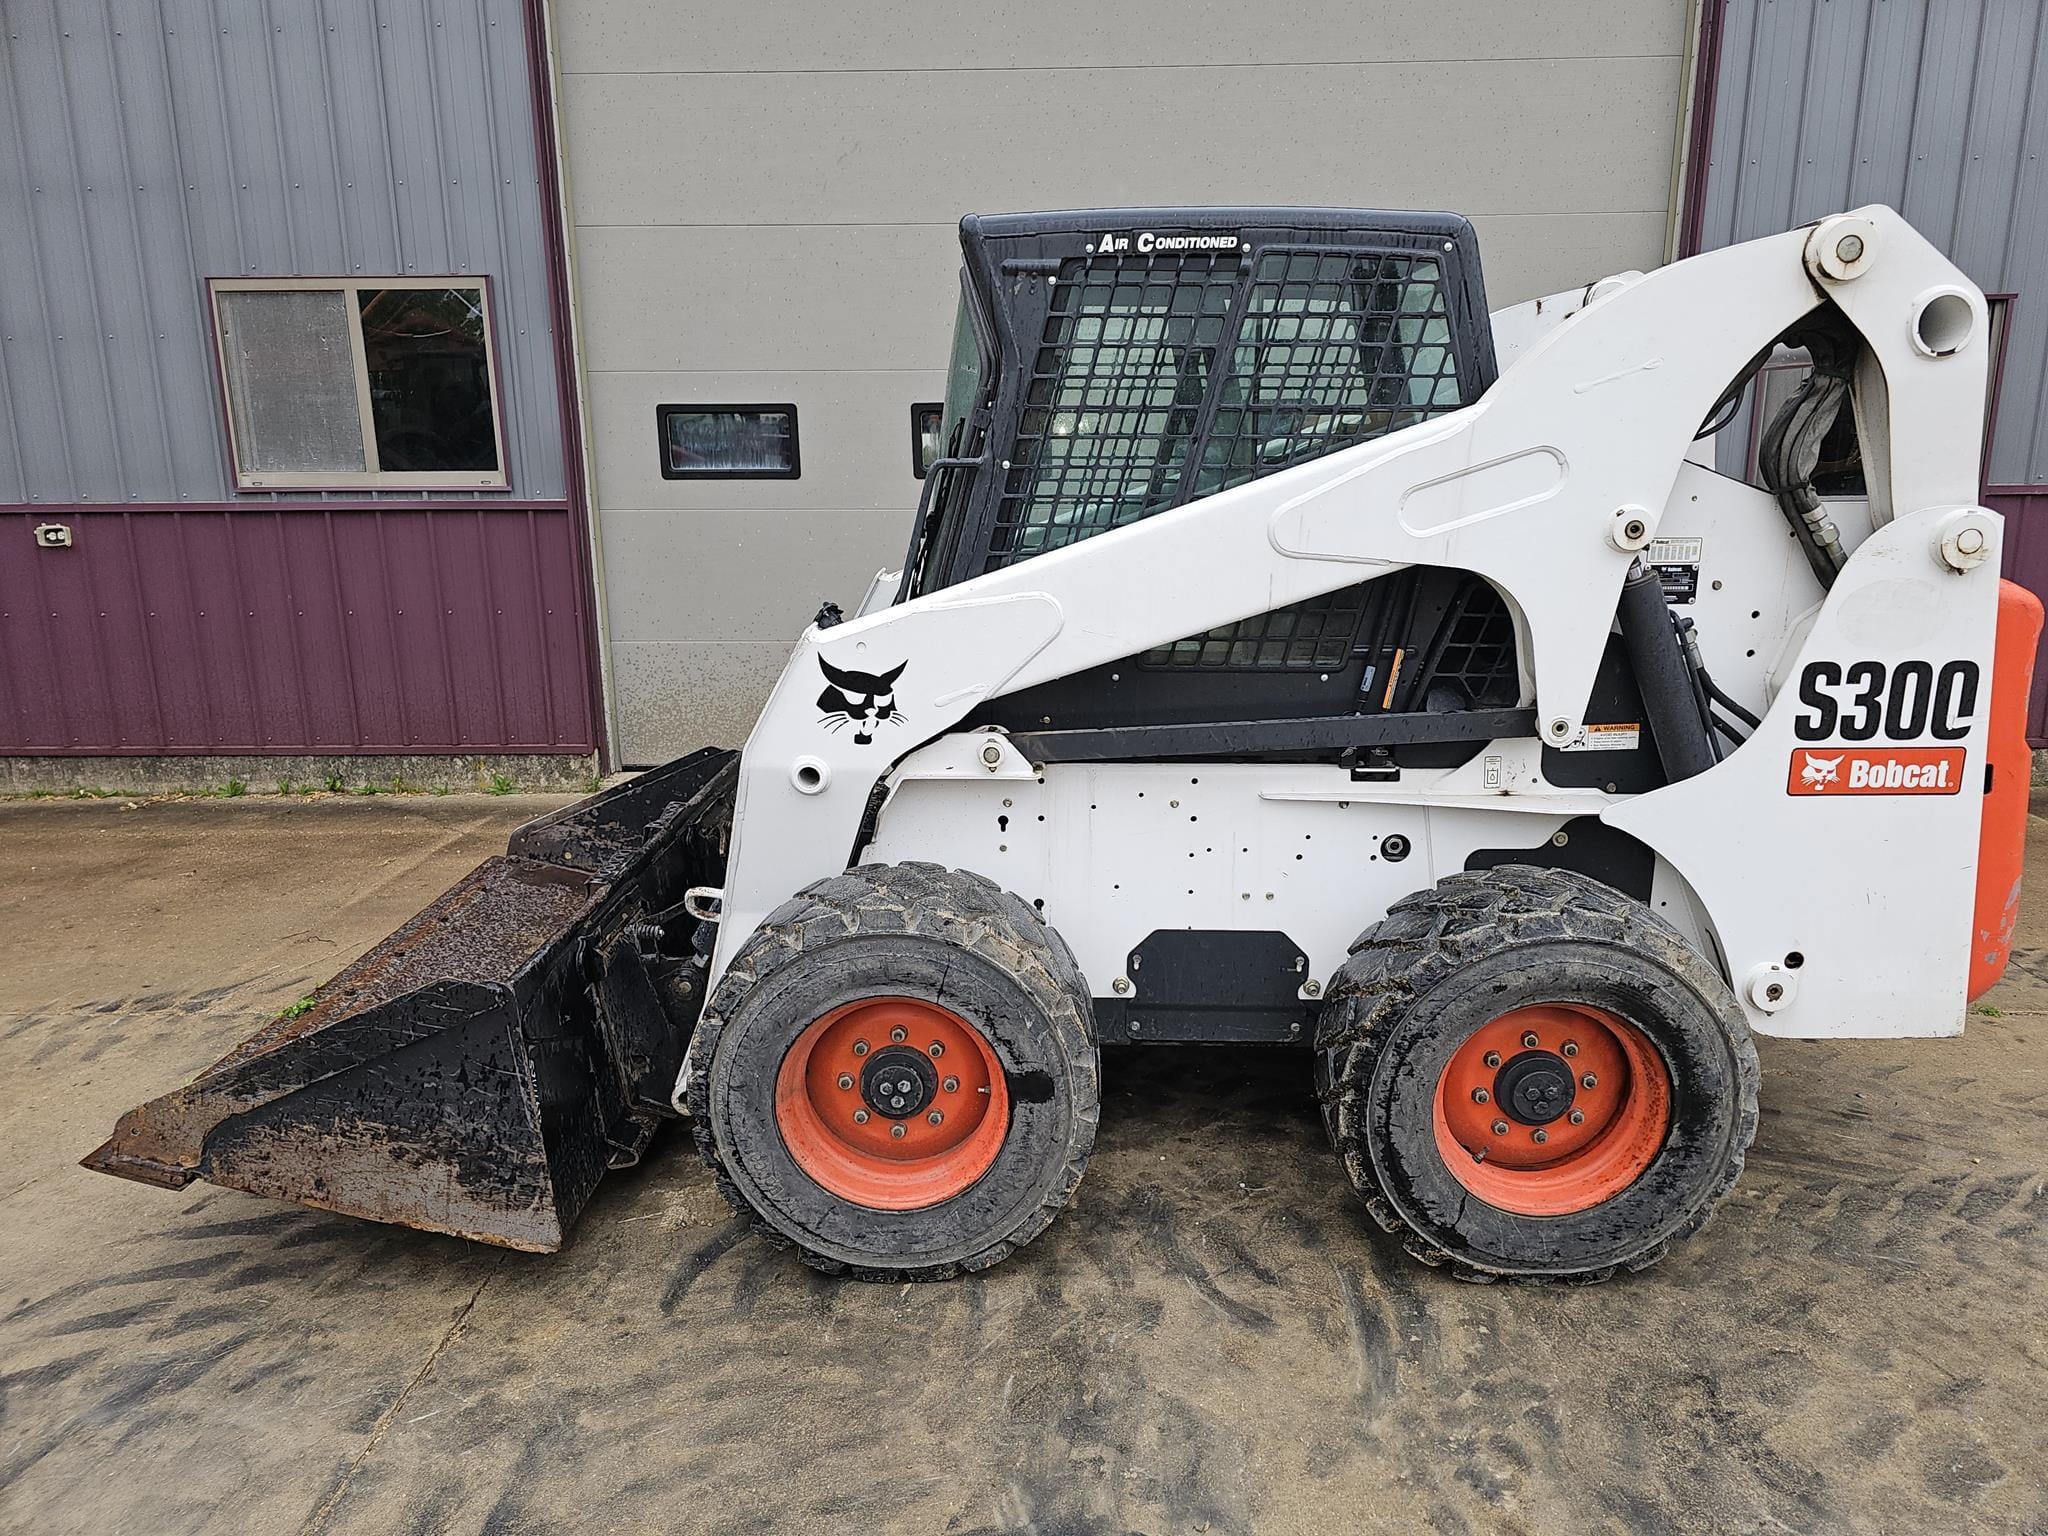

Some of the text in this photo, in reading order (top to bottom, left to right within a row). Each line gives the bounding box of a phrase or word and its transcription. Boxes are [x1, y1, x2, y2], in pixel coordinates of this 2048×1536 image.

[1098, 233, 1237, 252] AIR CONDITIONED
[1795, 660, 1979, 741] S300
[1849, 759, 1950, 788] Bobcat
